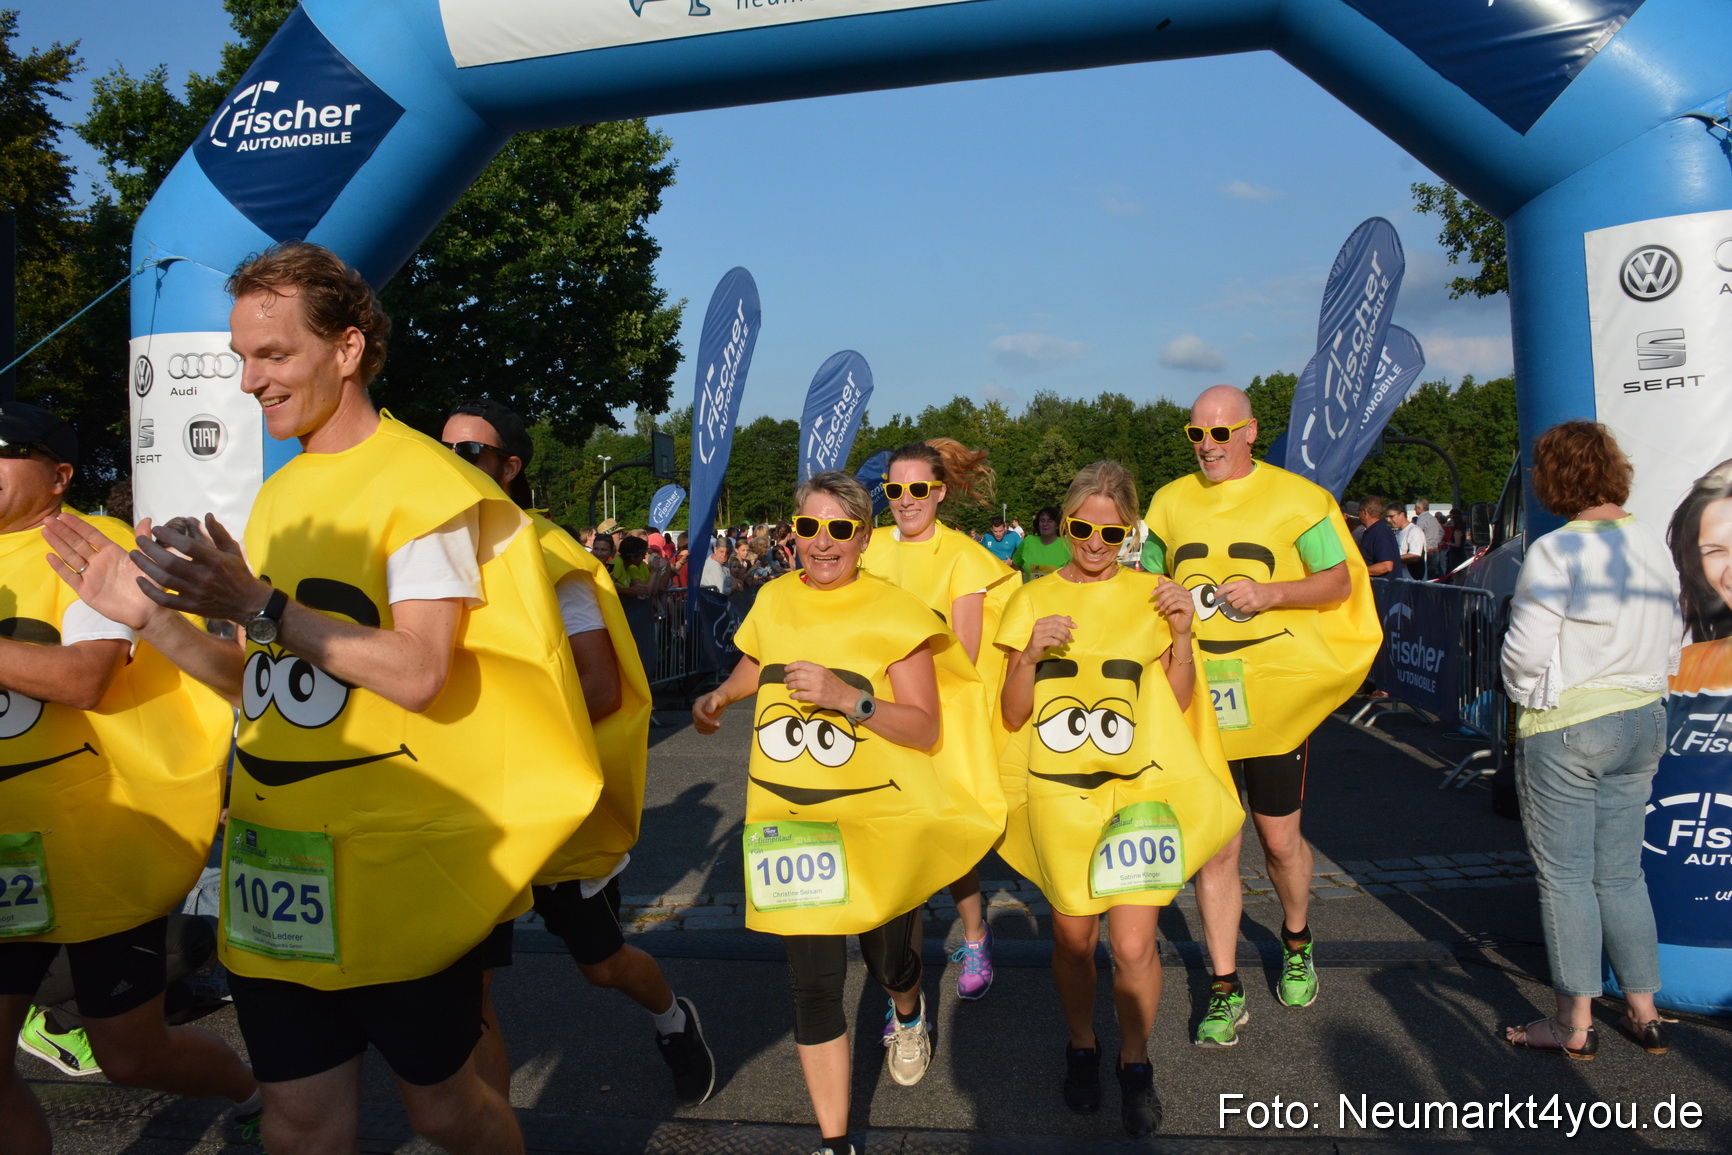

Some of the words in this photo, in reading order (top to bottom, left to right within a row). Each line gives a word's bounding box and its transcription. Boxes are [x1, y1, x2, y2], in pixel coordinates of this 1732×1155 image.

[228, 100, 361, 138] Fischer
[236, 131, 352, 152] AUTOMOBILE
[1335, 250, 1382, 412] Fischer
[1352, 274, 1390, 408] AUTOMOBILE
[706, 298, 745, 441] Fischer
[719, 322, 749, 439] AUTOMOBILE
[1623, 374, 1706, 394] SEAT
[170, 386, 197, 396] Audi
[815, 370, 857, 470] Fischer
[830, 387, 862, 468] AUTOMOBILE
[192, 427, 218, 448] FIAT
[1391, 631, 1445, 673] Fischer
[1682, 730, 1732, 753] Fis
[756, 852, 836, 886] 1009
[1099, 835, 1176, 870] 1006
[1684, 853, 1732, 866] AUT
[773, 889, 798, 898] Christine
[800, 888, 822, 896] Selsam
[1120, 873, 1141, 881] Sabine
[1142, 871, 1160, 879] Klinger
[235, 873, 324, 925] 1025
[272, 931, 303, 942] Lederer
